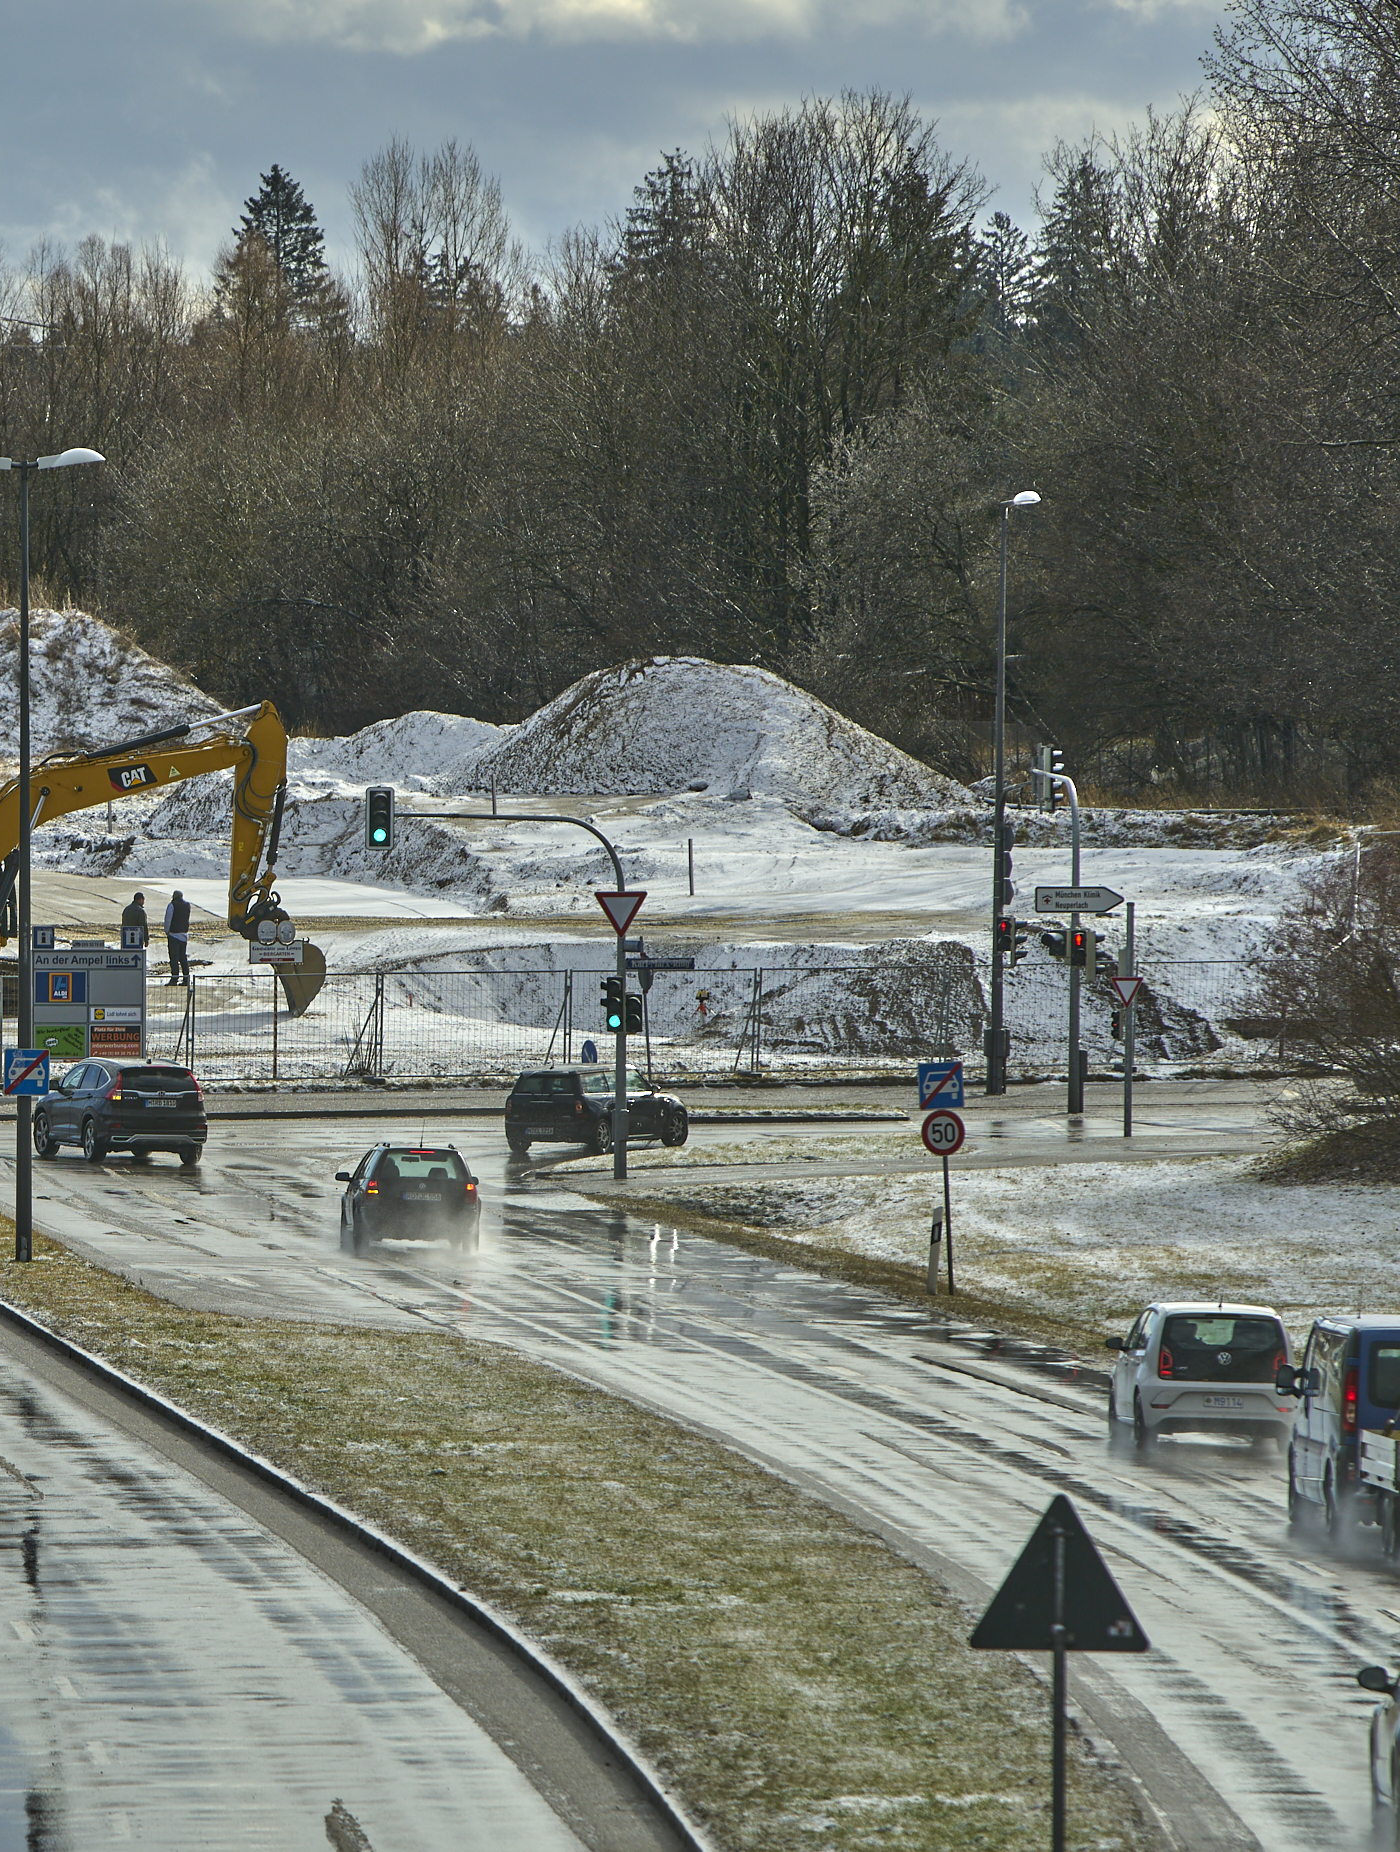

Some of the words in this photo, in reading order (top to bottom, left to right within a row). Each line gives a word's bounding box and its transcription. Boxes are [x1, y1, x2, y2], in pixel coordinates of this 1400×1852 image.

[121, 766, 147, 788] CAT
[1055, 890, 1081, 898] München
[1083, 890, 1101, 898] Klinik
[1055, 902, 1088, 910] Neuperlach
[35, 955, 49, 964] An
[52, 955, 69, 964] der
[71, 955, 103, 966] Ampel
[106, 955, 130, 964] links
[91, 1033, 140, 1041] WERBUNG
[932, 1122, 955, 1144] 50
